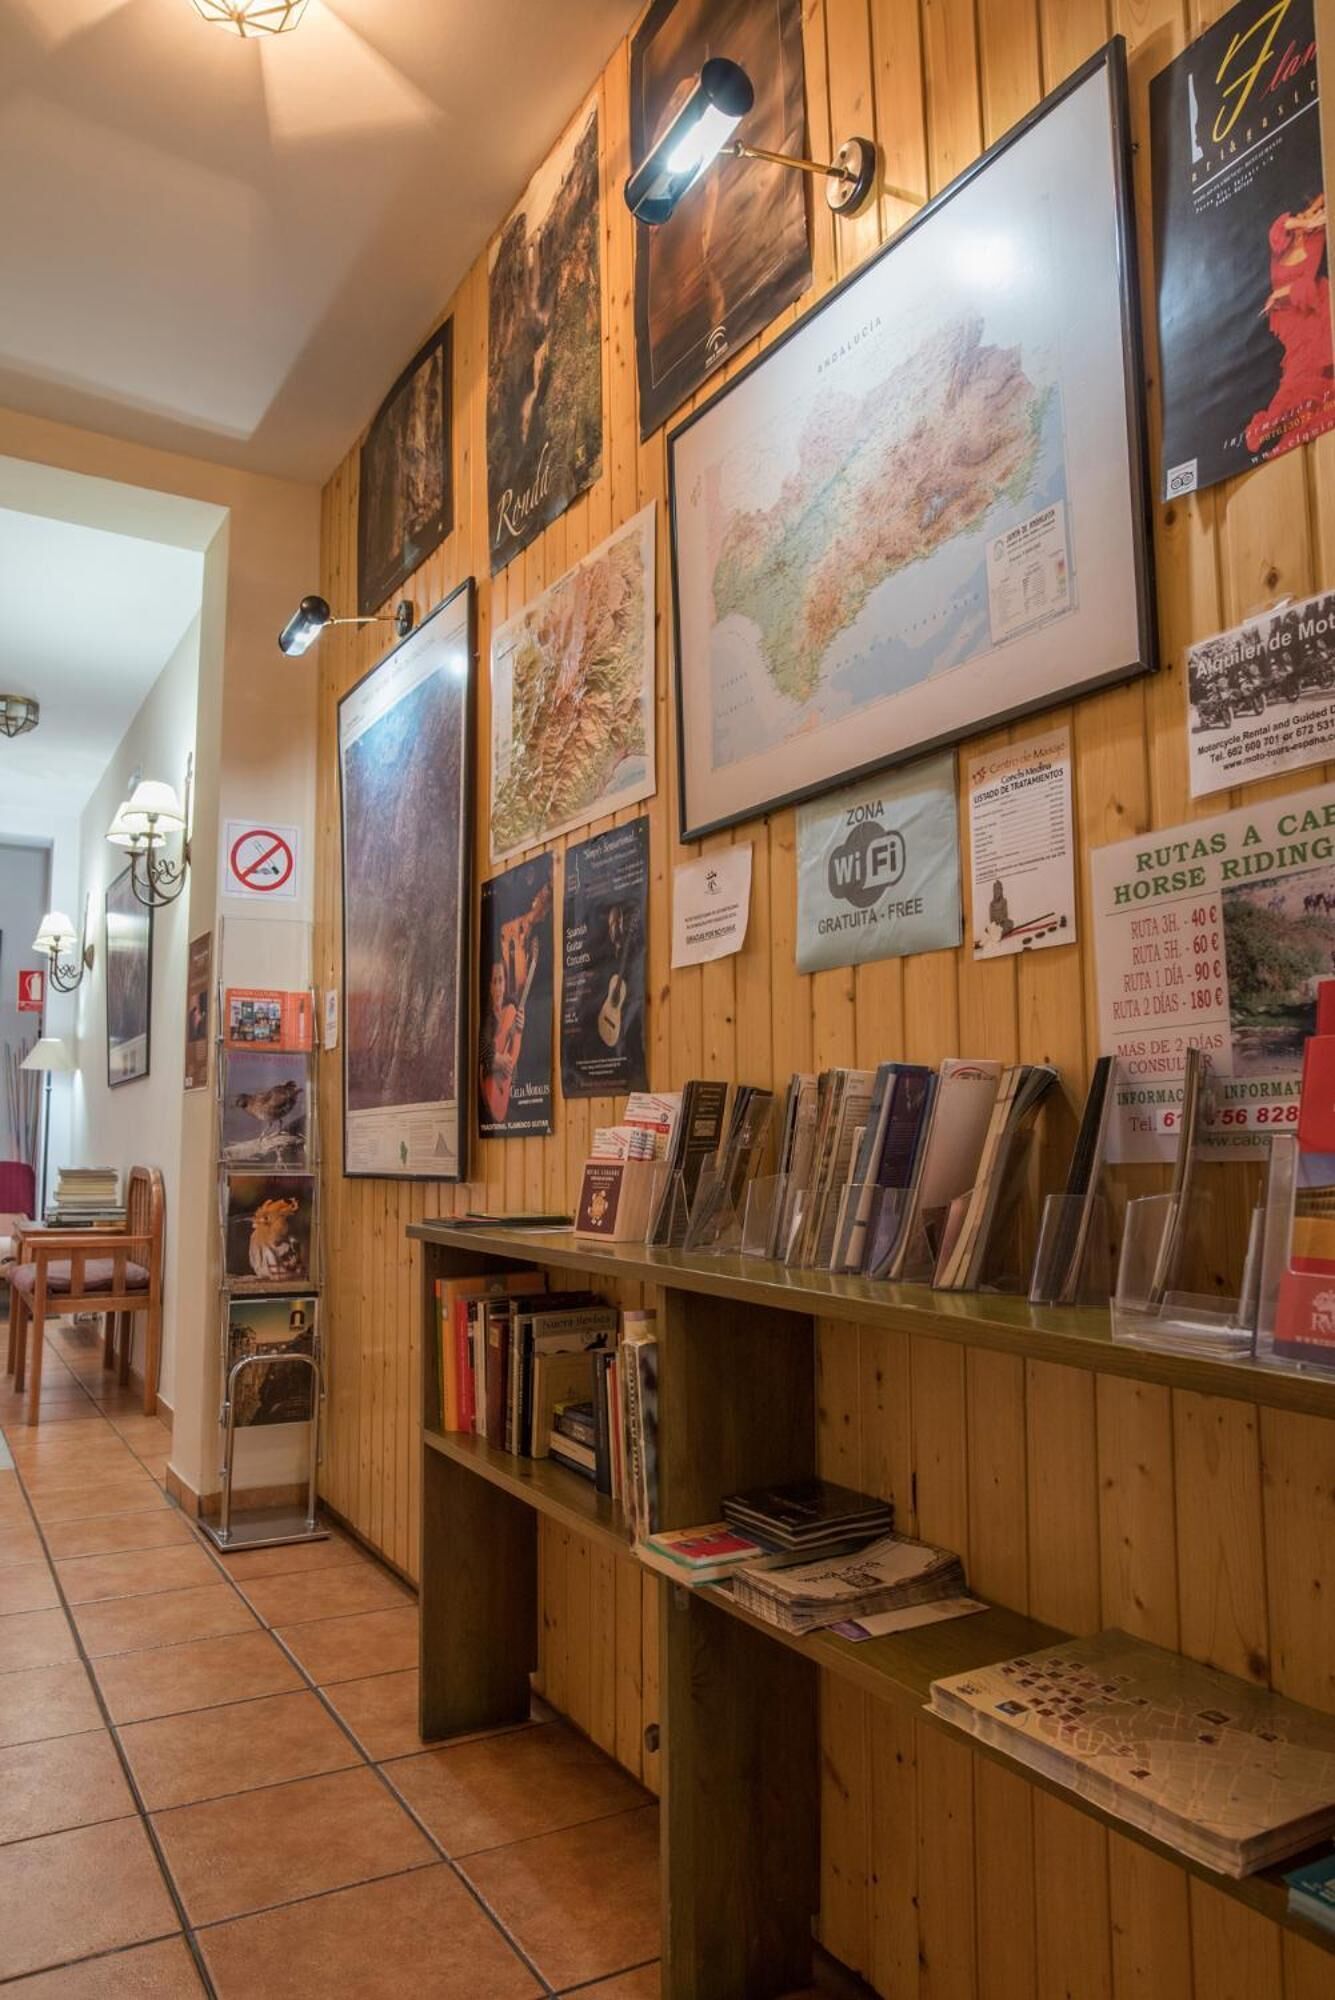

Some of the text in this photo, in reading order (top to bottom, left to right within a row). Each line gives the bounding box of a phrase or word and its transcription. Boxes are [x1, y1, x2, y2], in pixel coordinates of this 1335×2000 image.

[1270, 631, 1292, 651] de
[1243, 725, 1271, 740] Rental
[1273, 717, 1290, 731] and
[1292, 706, 1328, 724] Guided
[1283, 732, 1294, 742] or
[974, 768, 1064, 803] LISTADO DE TRATAMIENTOS
[846, 800, 885, 826] ZONA
[1136, 833, 1227, 872] RUTAS
[1243, 825, 1262, 846] A
[1113, 837, 1335, 905] HORSE RIDING
[818, 910, 877, 935] GRATUITA
[887, 898, 924, 920] FREE
[1131, 916, 1160, 940] RUTA
[1191, 907, 1206, 927] 40
[1209, 905, 1217, 924] €
[1132, 943, 1161, 966] RUTA
[1193, 934, 1208, 954] 60
[1211, 932, 1219, 951] €
[1124, 972, 1150, 993] RUTA
[1155, 969, 1160, 988] 1
[1164, 963, 1184, 988] DÍA
[1194, 962, 1209, 982] 90
[1213, 960, 1221, 979] €
[1113, 998, 1140, 1020] RUTA
[1143, 997, 1149, 1016] 2
[1153, 991, 1179, 1015] DÍAS
[1191, 989, 1211, 1010] 180
[1215, 987, 1224, 1006] €
[1152, 1039, 1171, 1055] DE
[1177, 1038, 1185, 1053] 2
[1188, 1034, 1223, 1050] DÍAS
[1130, 1117, 1158, 1132] Tel.
[1257, 1105, 1298, 1123] 828
